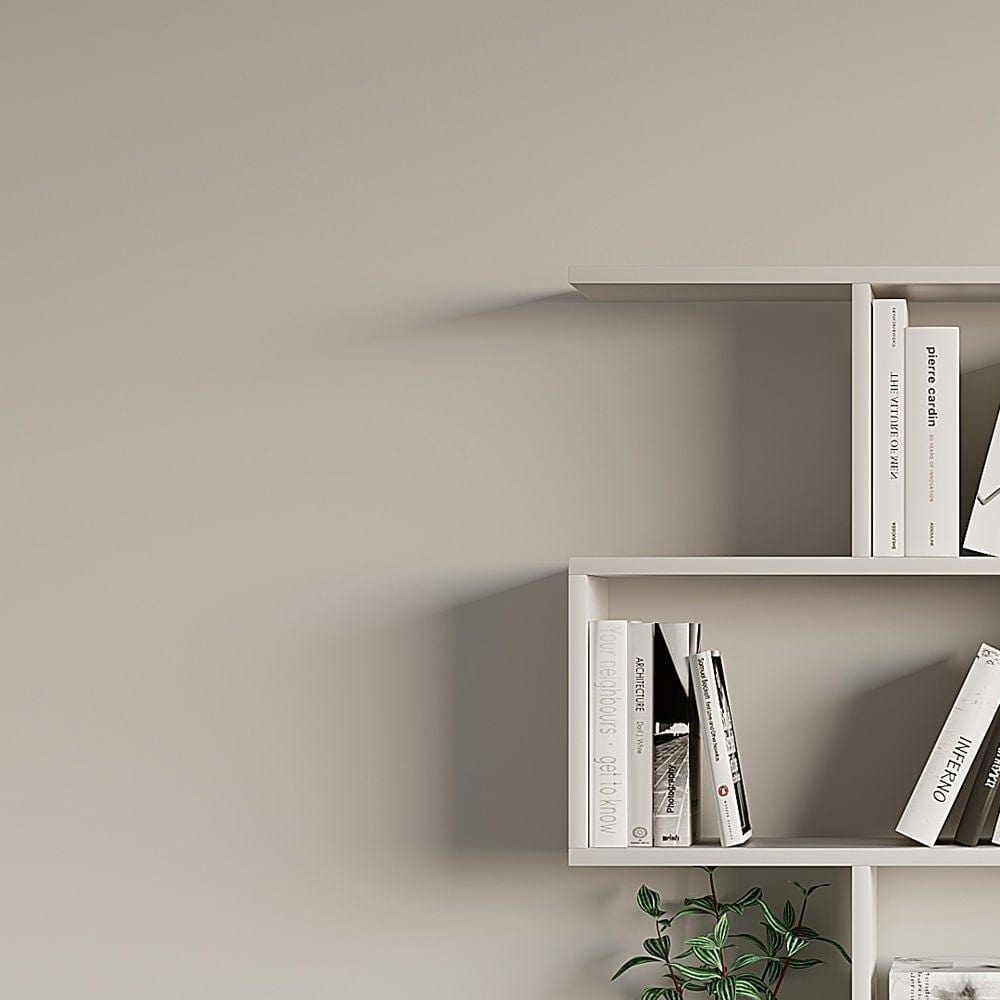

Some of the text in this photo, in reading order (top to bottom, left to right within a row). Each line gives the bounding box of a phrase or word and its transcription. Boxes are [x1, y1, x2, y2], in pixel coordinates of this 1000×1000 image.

[926, 347, 938, 426] pierre cardin
[635, 658, 644, 711] ARCHITECTURE
[697, 658, 710, 699] Samuel Beckett
[593, 627, 623, 834] Your neighbours get to know
[665, 765, 676, 814] Photography
[933, 736, 972, 803] INFERNO
